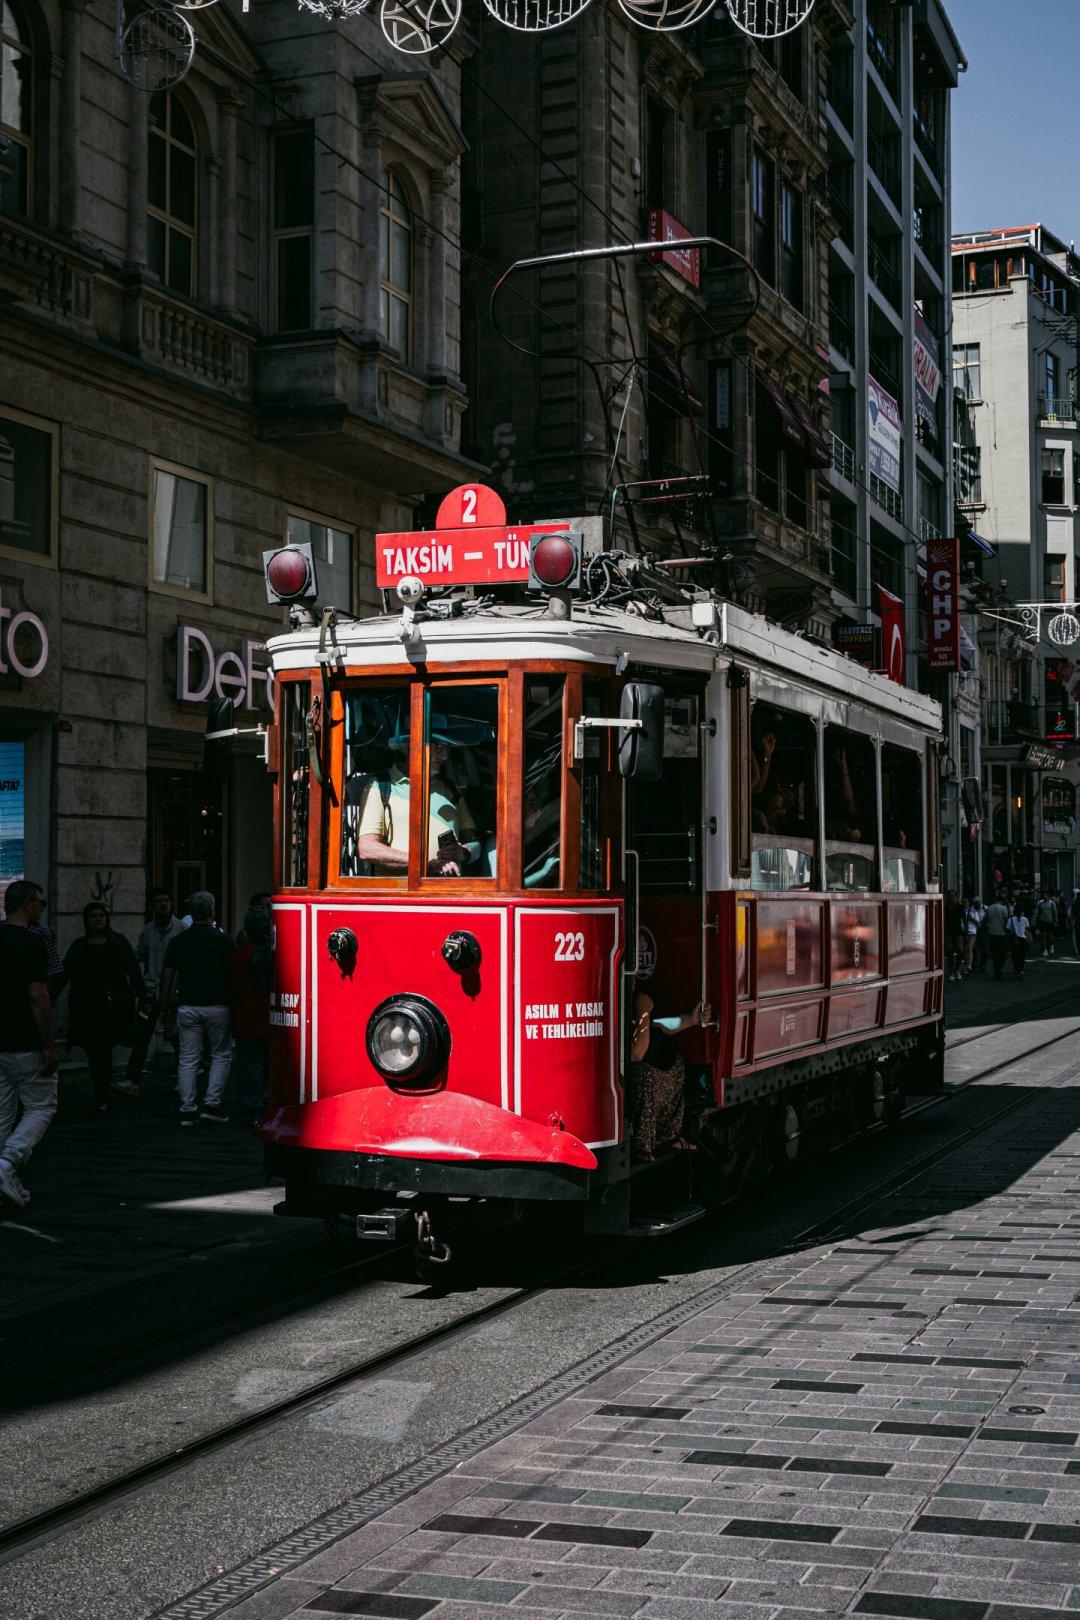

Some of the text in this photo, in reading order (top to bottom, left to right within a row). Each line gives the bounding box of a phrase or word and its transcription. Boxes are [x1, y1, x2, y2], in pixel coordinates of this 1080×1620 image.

[462, 489, 477, 523] 2
[383, 538, 453, 575] TAKSİM
[932, 570, 952, 640] CHP
[838, 635, 873, 643] COIFFEUR
[554, 932, 585, 961] 223
[575, 1002, 604, 1017] YASAK
[525, 1019, 604, 1039] VE TEHLİKELİDİR
